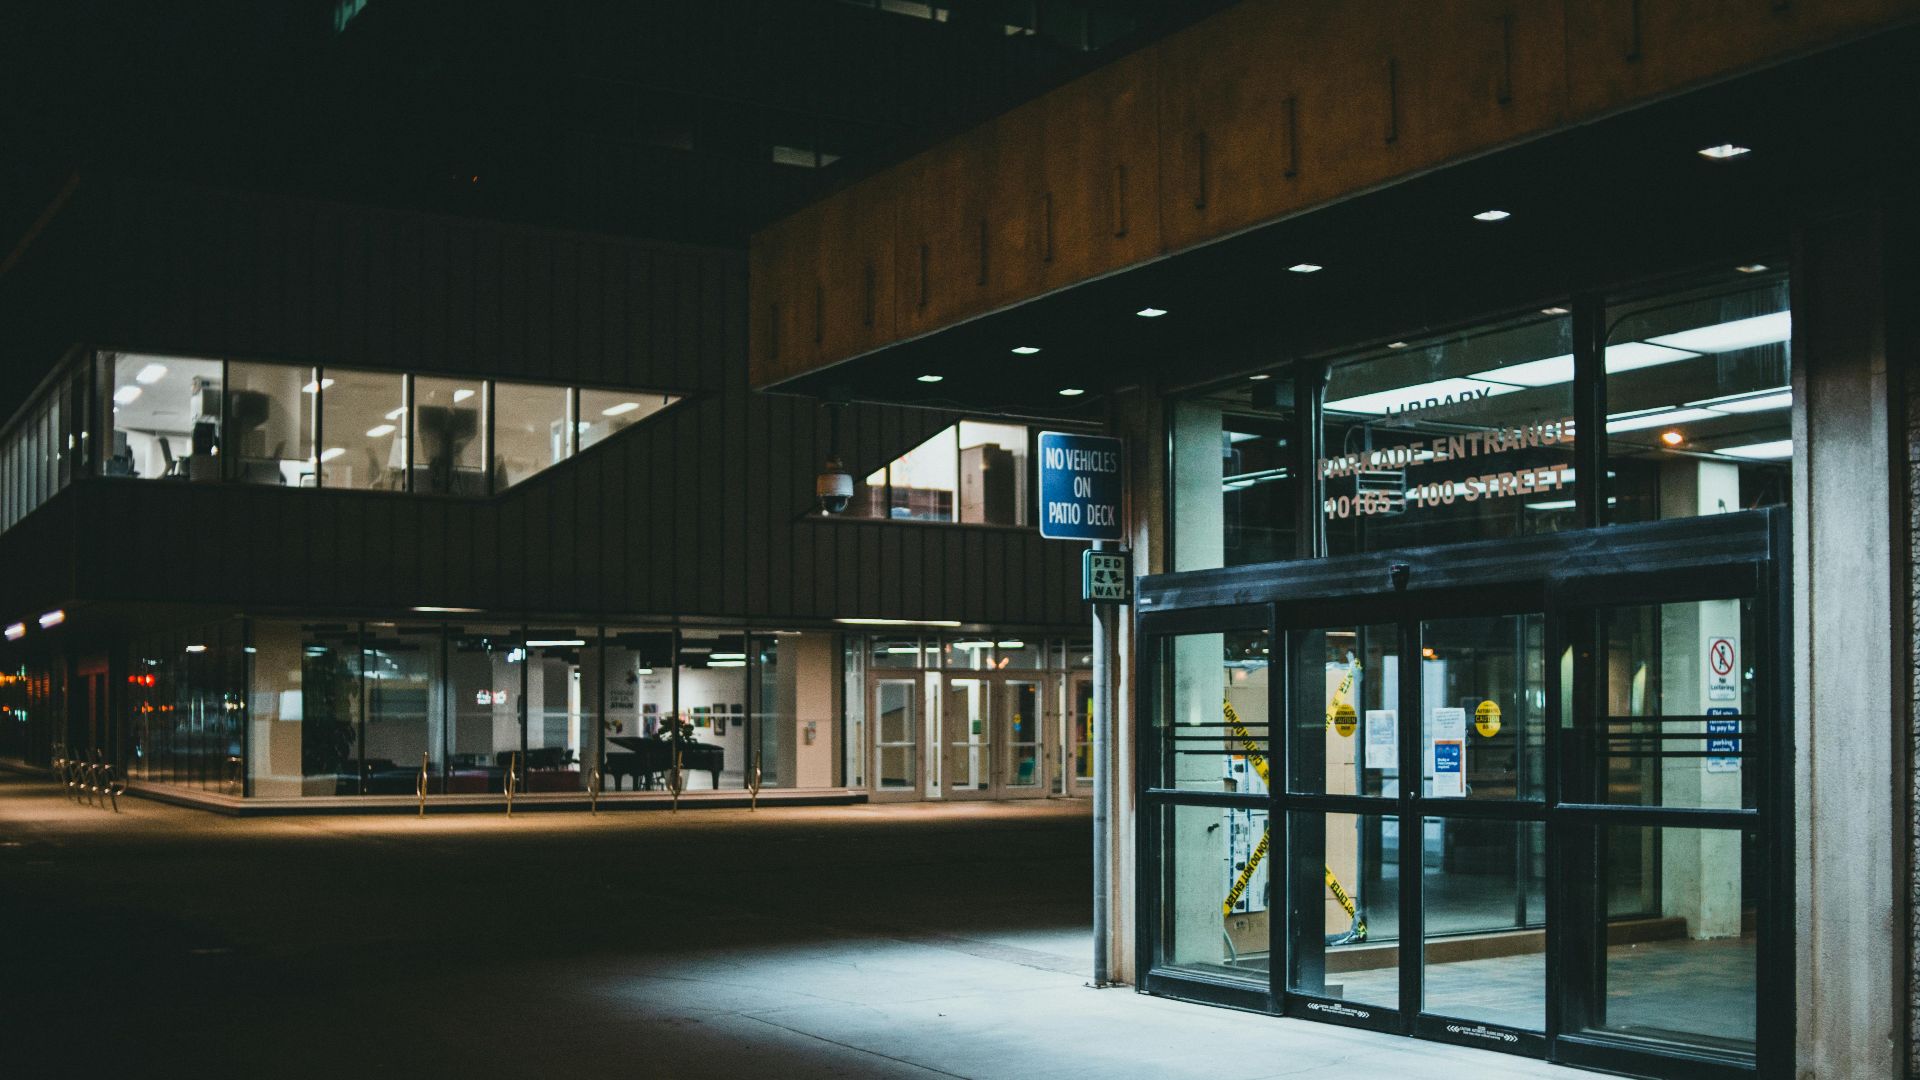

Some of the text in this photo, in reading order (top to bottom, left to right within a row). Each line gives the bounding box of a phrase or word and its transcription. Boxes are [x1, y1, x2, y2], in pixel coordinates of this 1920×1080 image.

[1386, 387, 1491, 427] LIBRARY
[1046, 447, 1117, 473] NO VEHICLES
[1317, 416, 1576, 480] PARKADE ENTRANCE
[1073, 476, 1091, 498] ON
[1327, 490, 1391, 519] 10165
[1416, 480, 1455, 508] 100
[1464, 463, 1568, 502] STREET
[1049, 501, 1115, 526] PATIO DECK
[1094, 557, 1122, 569] PED
[1094, 585, 1122, 597] WAY
[1223, 704, 1236, 723] NOT
[1240, 730, 1264, 767] CATION
[1713, 738, 1733, 747] parking
[1250, 853, 1262, 868] DO
[1240, 865, 1255, 884] NOT
[1225, 880, 1245, 908] ENTER
[1330, 880, 1348, 905] ENTER
